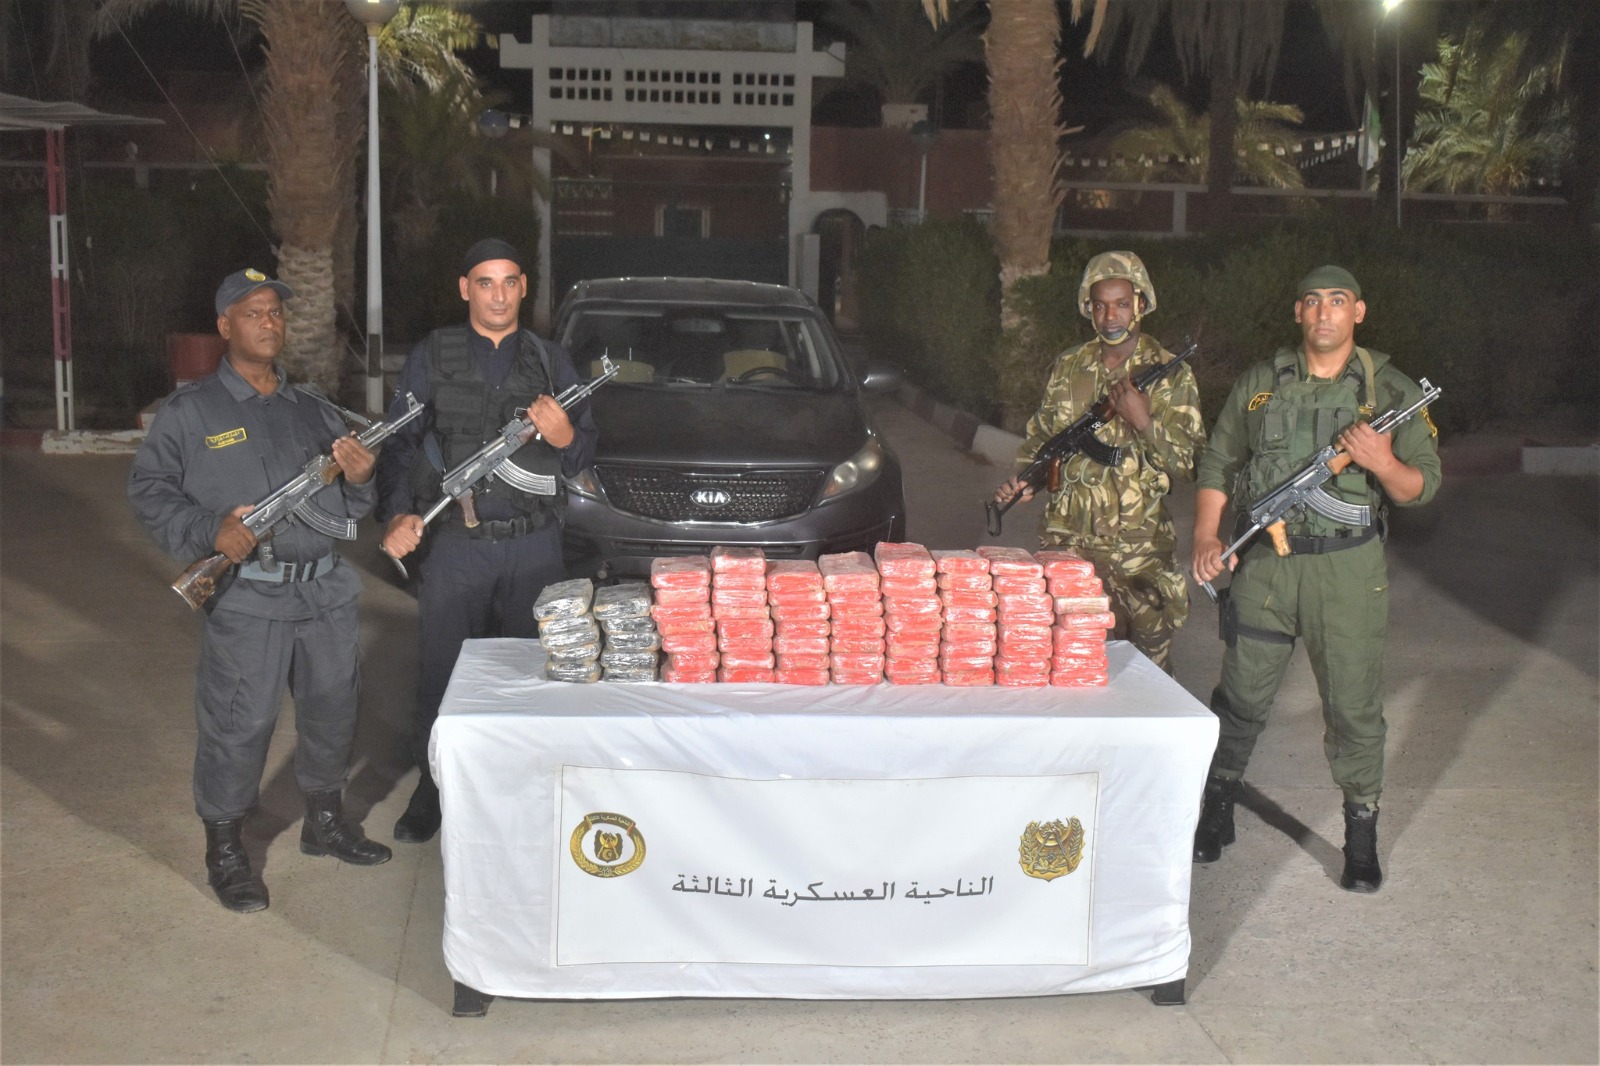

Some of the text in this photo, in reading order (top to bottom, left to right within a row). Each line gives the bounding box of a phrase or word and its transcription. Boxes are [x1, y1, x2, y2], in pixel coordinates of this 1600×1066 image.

[697, 491, 726, 503] KIA
[672, 874, 994, 907] الناحية العسكرية الثالثة
